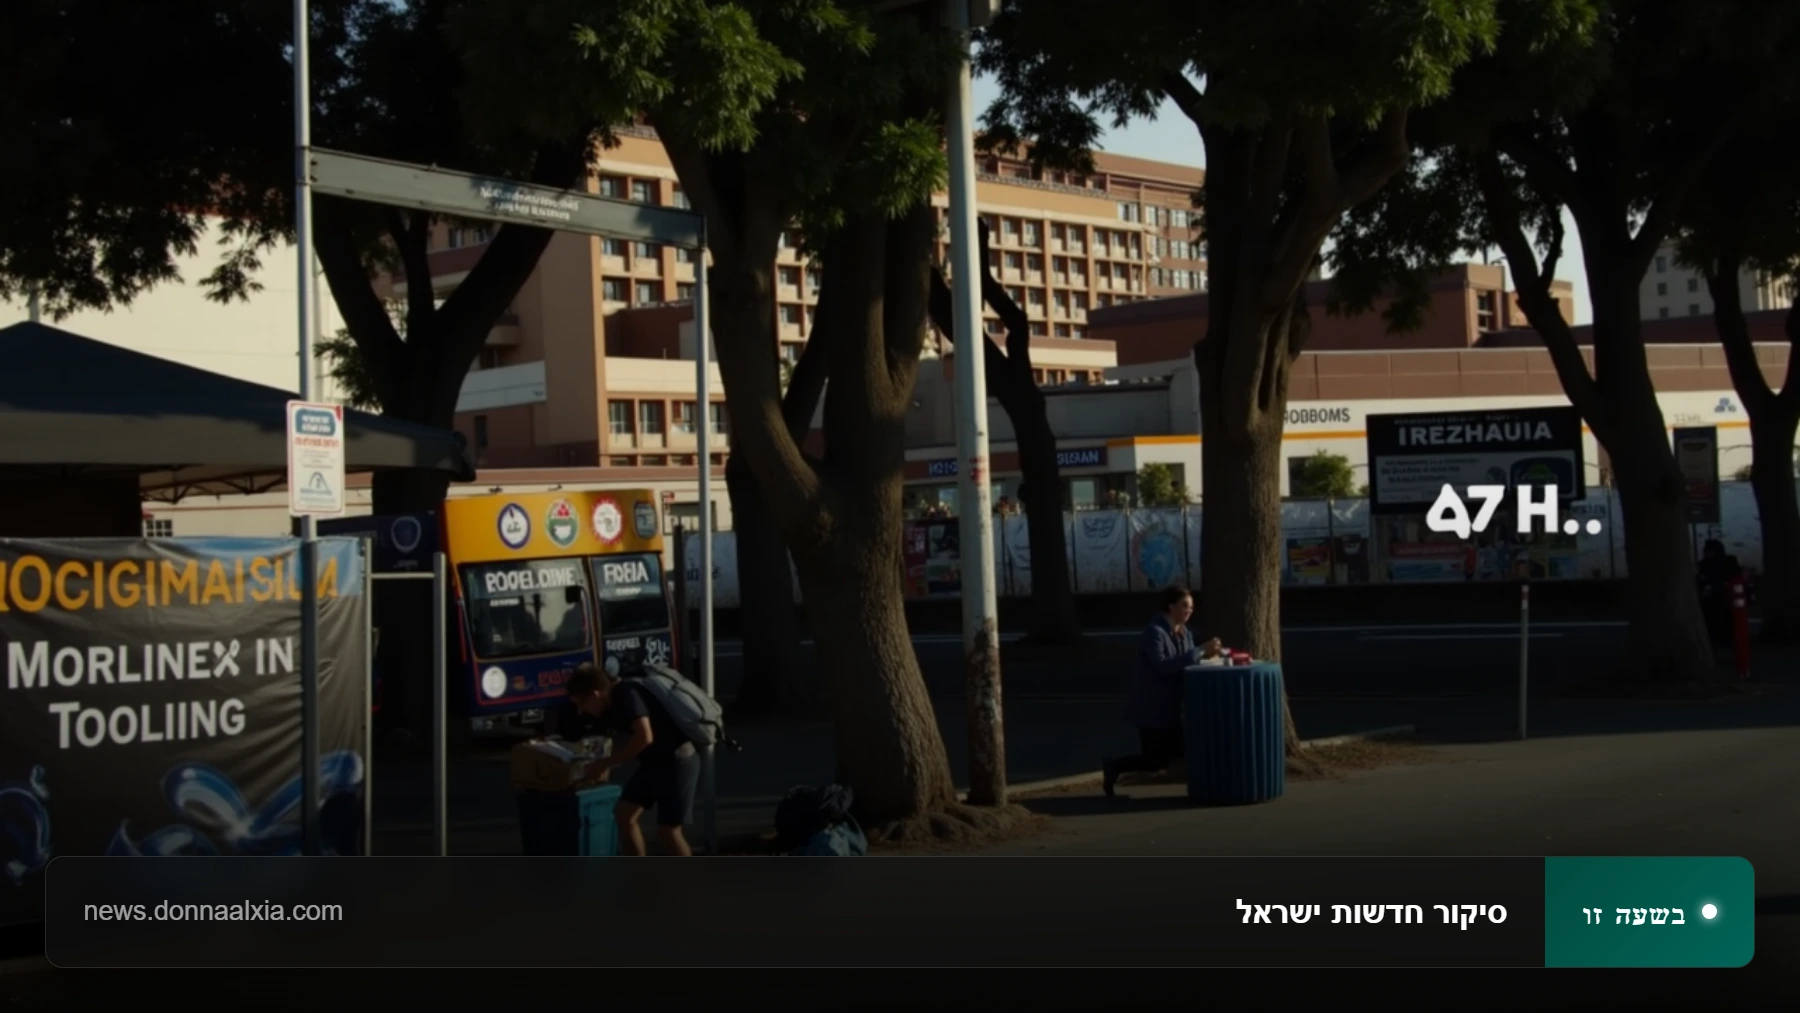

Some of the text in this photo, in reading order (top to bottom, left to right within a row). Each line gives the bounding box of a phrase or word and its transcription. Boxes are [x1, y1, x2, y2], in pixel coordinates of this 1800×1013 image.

[1398, 420, 1554, 446] IREZHAUIA
[256, 637, 295, 676] IN
[49, 698, 246, 750] TOOLIING
